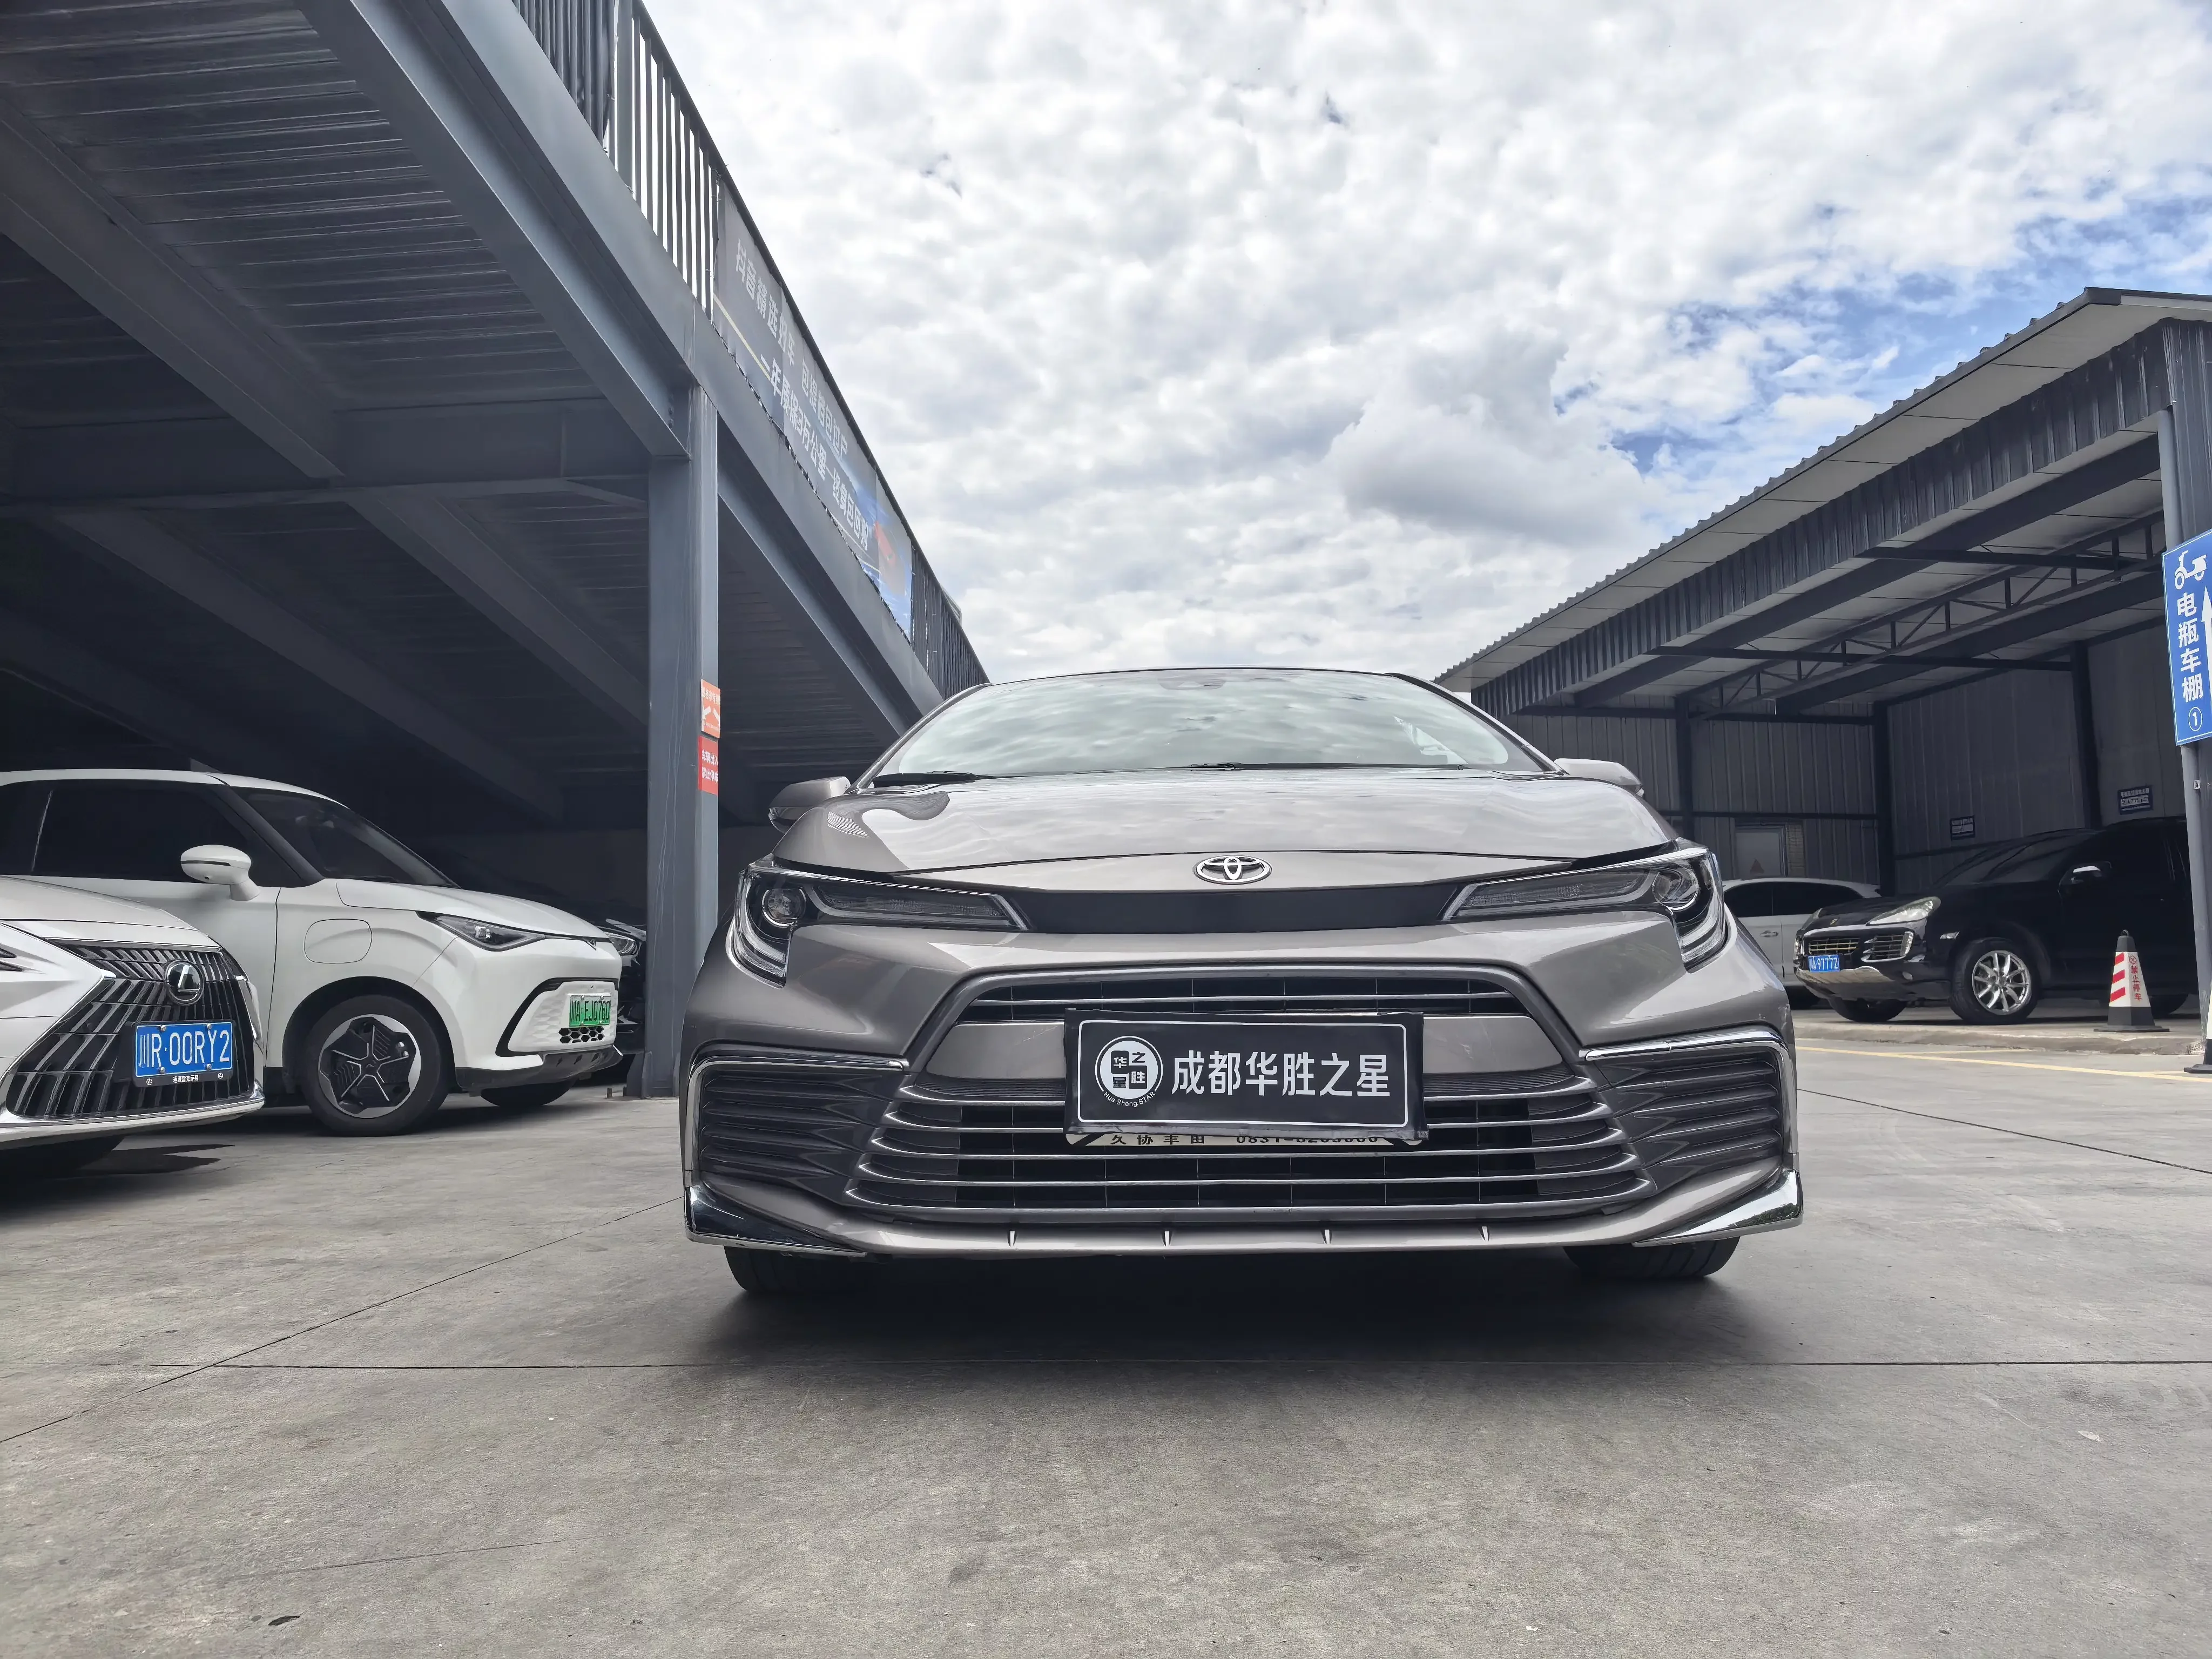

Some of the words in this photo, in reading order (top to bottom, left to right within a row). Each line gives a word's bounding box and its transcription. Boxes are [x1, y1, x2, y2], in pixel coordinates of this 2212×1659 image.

[736, 238, 795, 366] 抖音精选好车
[2177, 592, 2203, 703] 电瓶车棚
[2130, 964, 2142, 1002] 禁止停车
[1172, 1050, 1391, 1097] 成都华胜之星
[1103, 1091, 1116, 1103] Hua
[1111, 1134, 1204, 1145] 久协丰田
